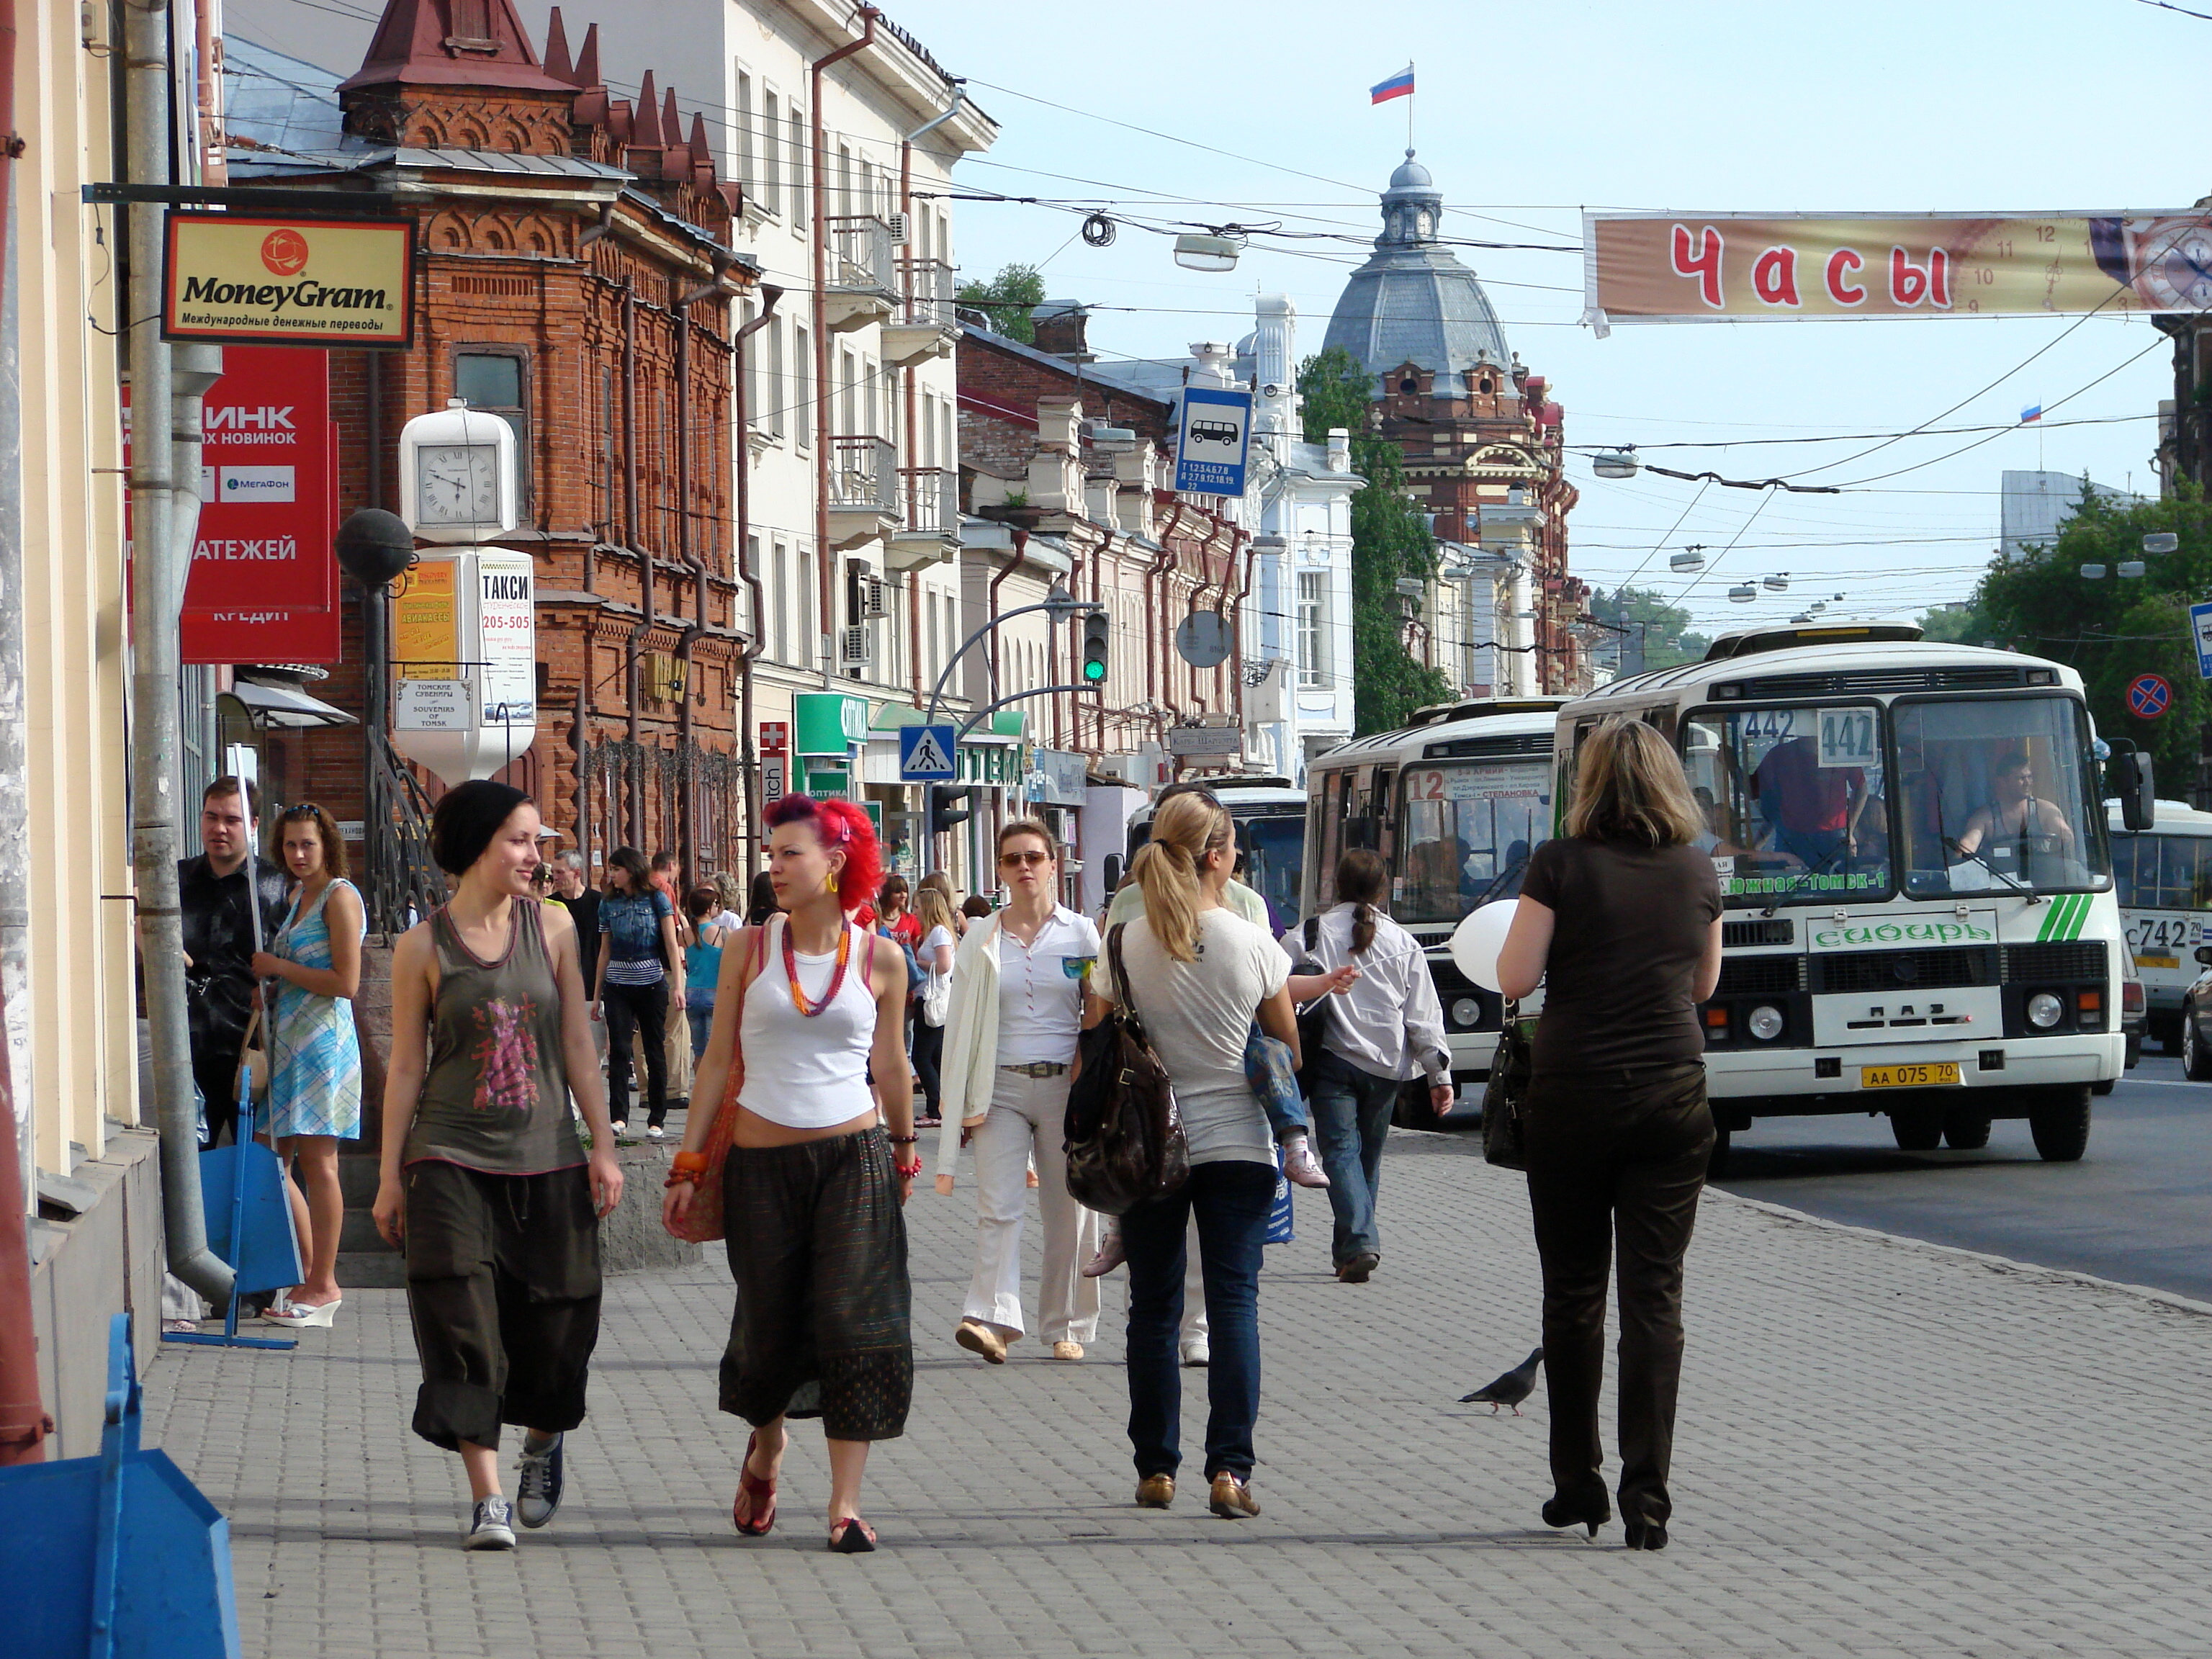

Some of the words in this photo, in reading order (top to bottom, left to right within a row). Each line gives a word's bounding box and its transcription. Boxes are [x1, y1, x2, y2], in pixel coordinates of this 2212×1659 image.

[2036, 226, 2055, 242] 12
[1997, 240, 2013, 257] 11
[1671, 225, 1952, 310] Часы
[1974, 269, 1994, 284] 10
[182, 276, 386, 312] MoneyGram
[181, 313, 269, 328] Международные
[272, 315, 327, 330] денежные
[329, 318, 383, 332] переводы
[221, 433, 297, 444] НОВИНОК
[193, 535, 297, 559] АТЕЖЕЙ
[482, 575, 529, 600] ТАКСИ
[402, 612, 450, 624] АВИАКАССЫ
[483, 616, 529, 629] 205-505
[956, 746, 1022, 782] ПТЕКА
[1408, 772, 1444, 800] 12
[1483, 789, 1539, 798] СТЕПАНОВКА
[1897, 1066, 1928, 1083] 075
[1938, 1065, 1953, 1076] 70
